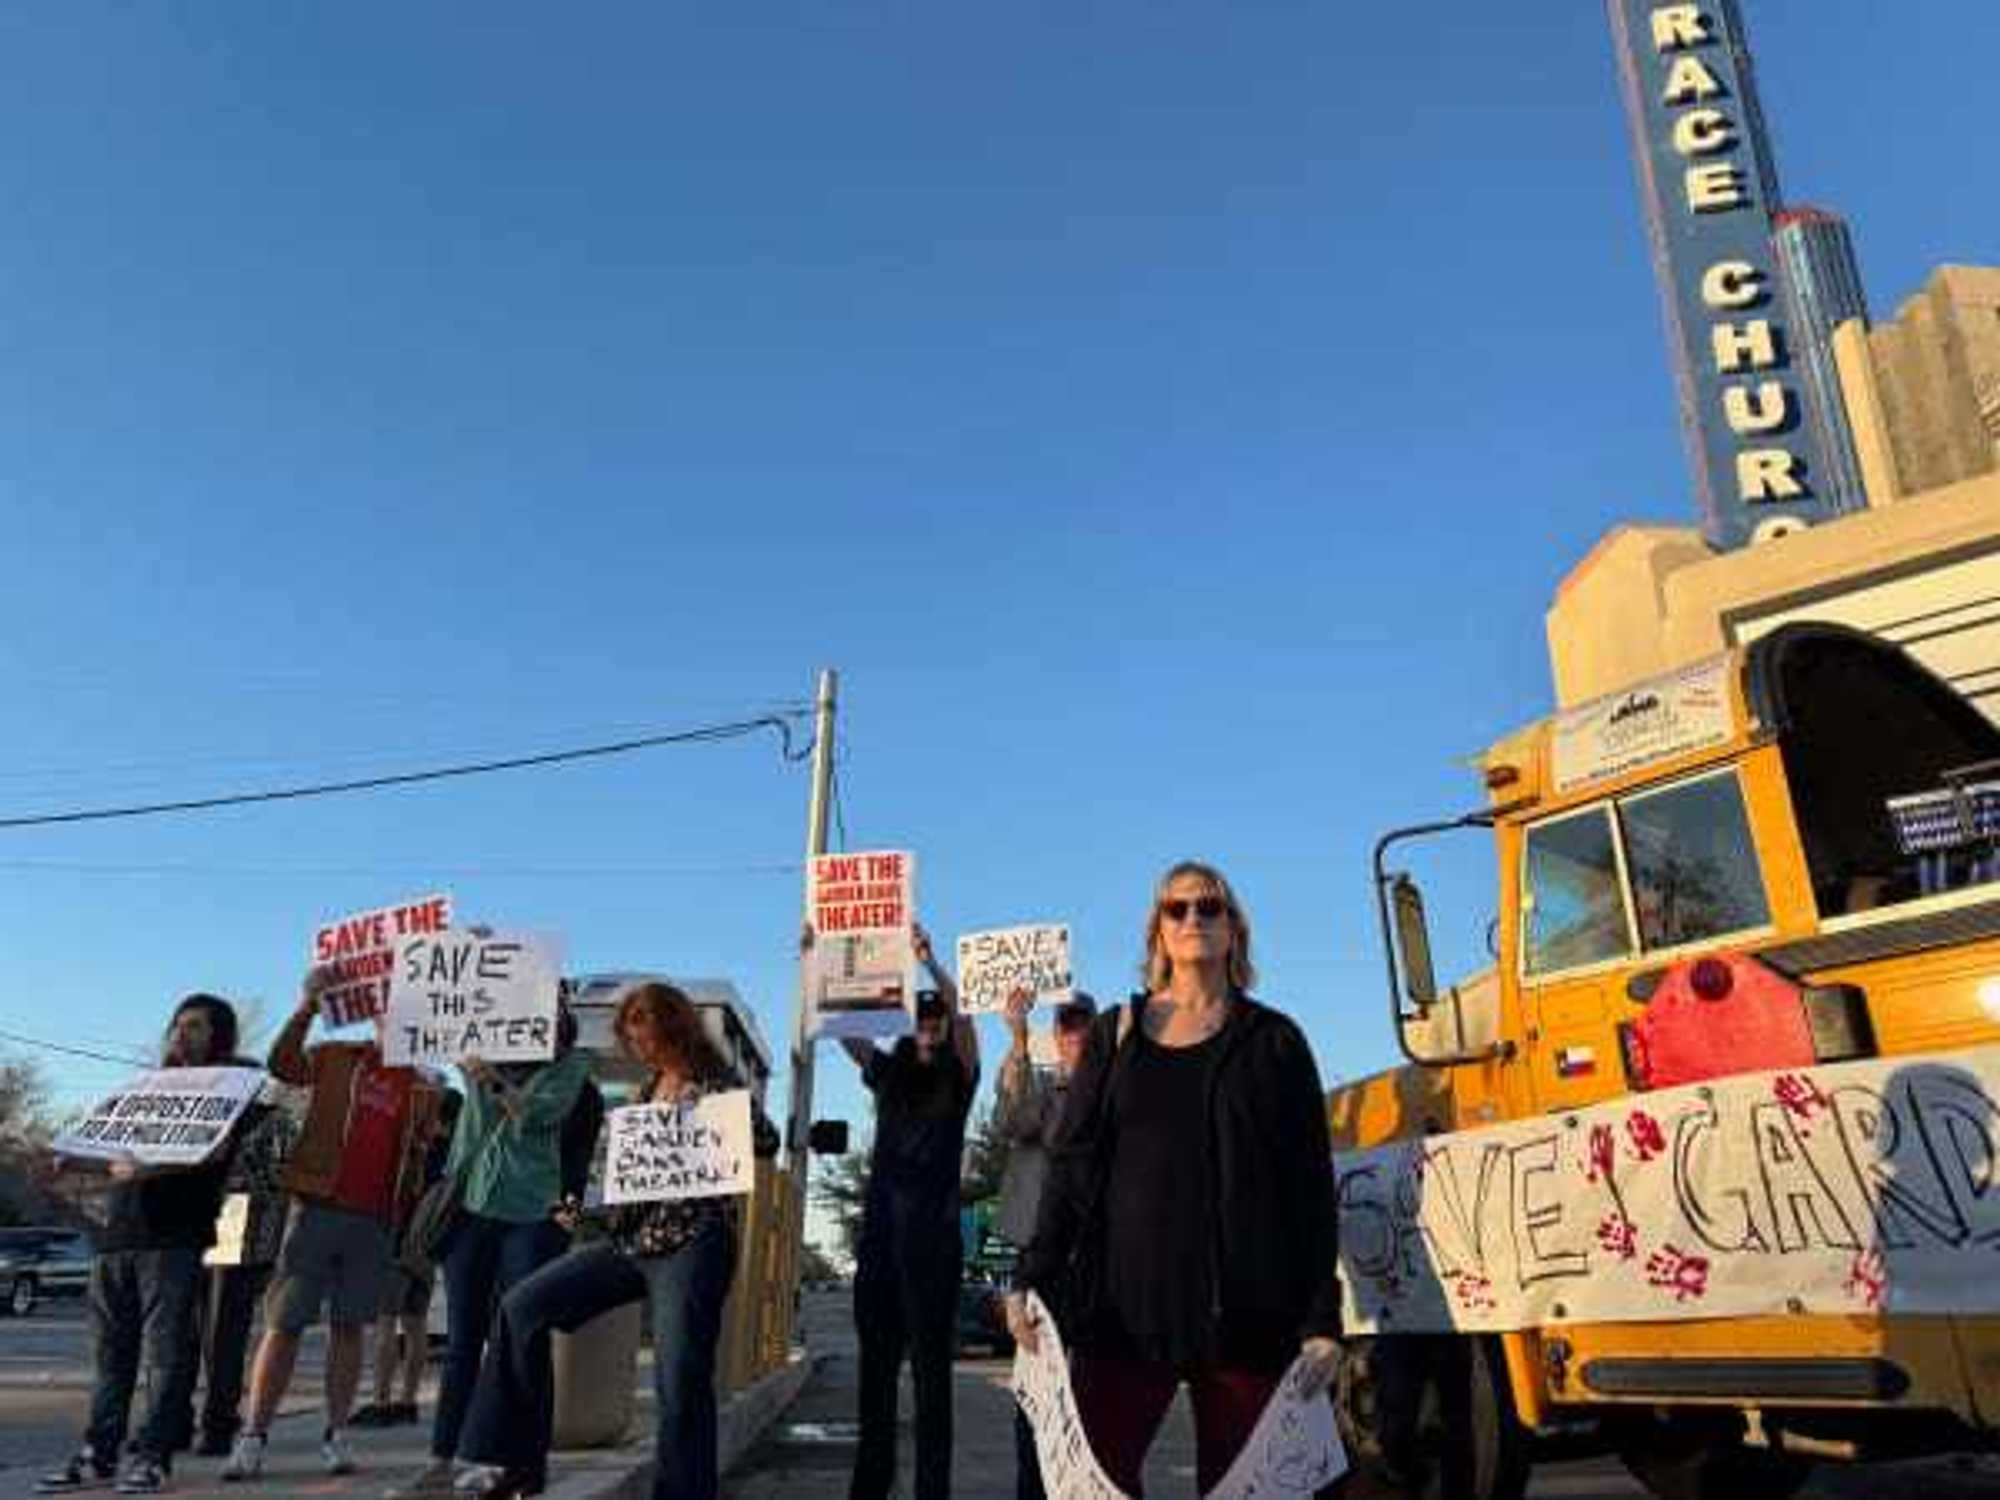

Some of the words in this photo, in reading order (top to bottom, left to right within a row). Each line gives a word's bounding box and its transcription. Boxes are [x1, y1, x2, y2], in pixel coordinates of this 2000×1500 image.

[1650, 4, 1741, 212] RACE
[815, 857, 861, 883] SAVE
[867, 854, 905, 880] THE
[316, 914, 386, 962] SAVE
[391, 899, 449, 935] THE
[816, 902, 906, 932] THEATER!
[403, 940, 523, 986] SAVE
[426, 986, 497, 1017] THIS
[403, 1016, 551, 1055] THEATER
[1338, 1134, 1590, 1292] SAVE
